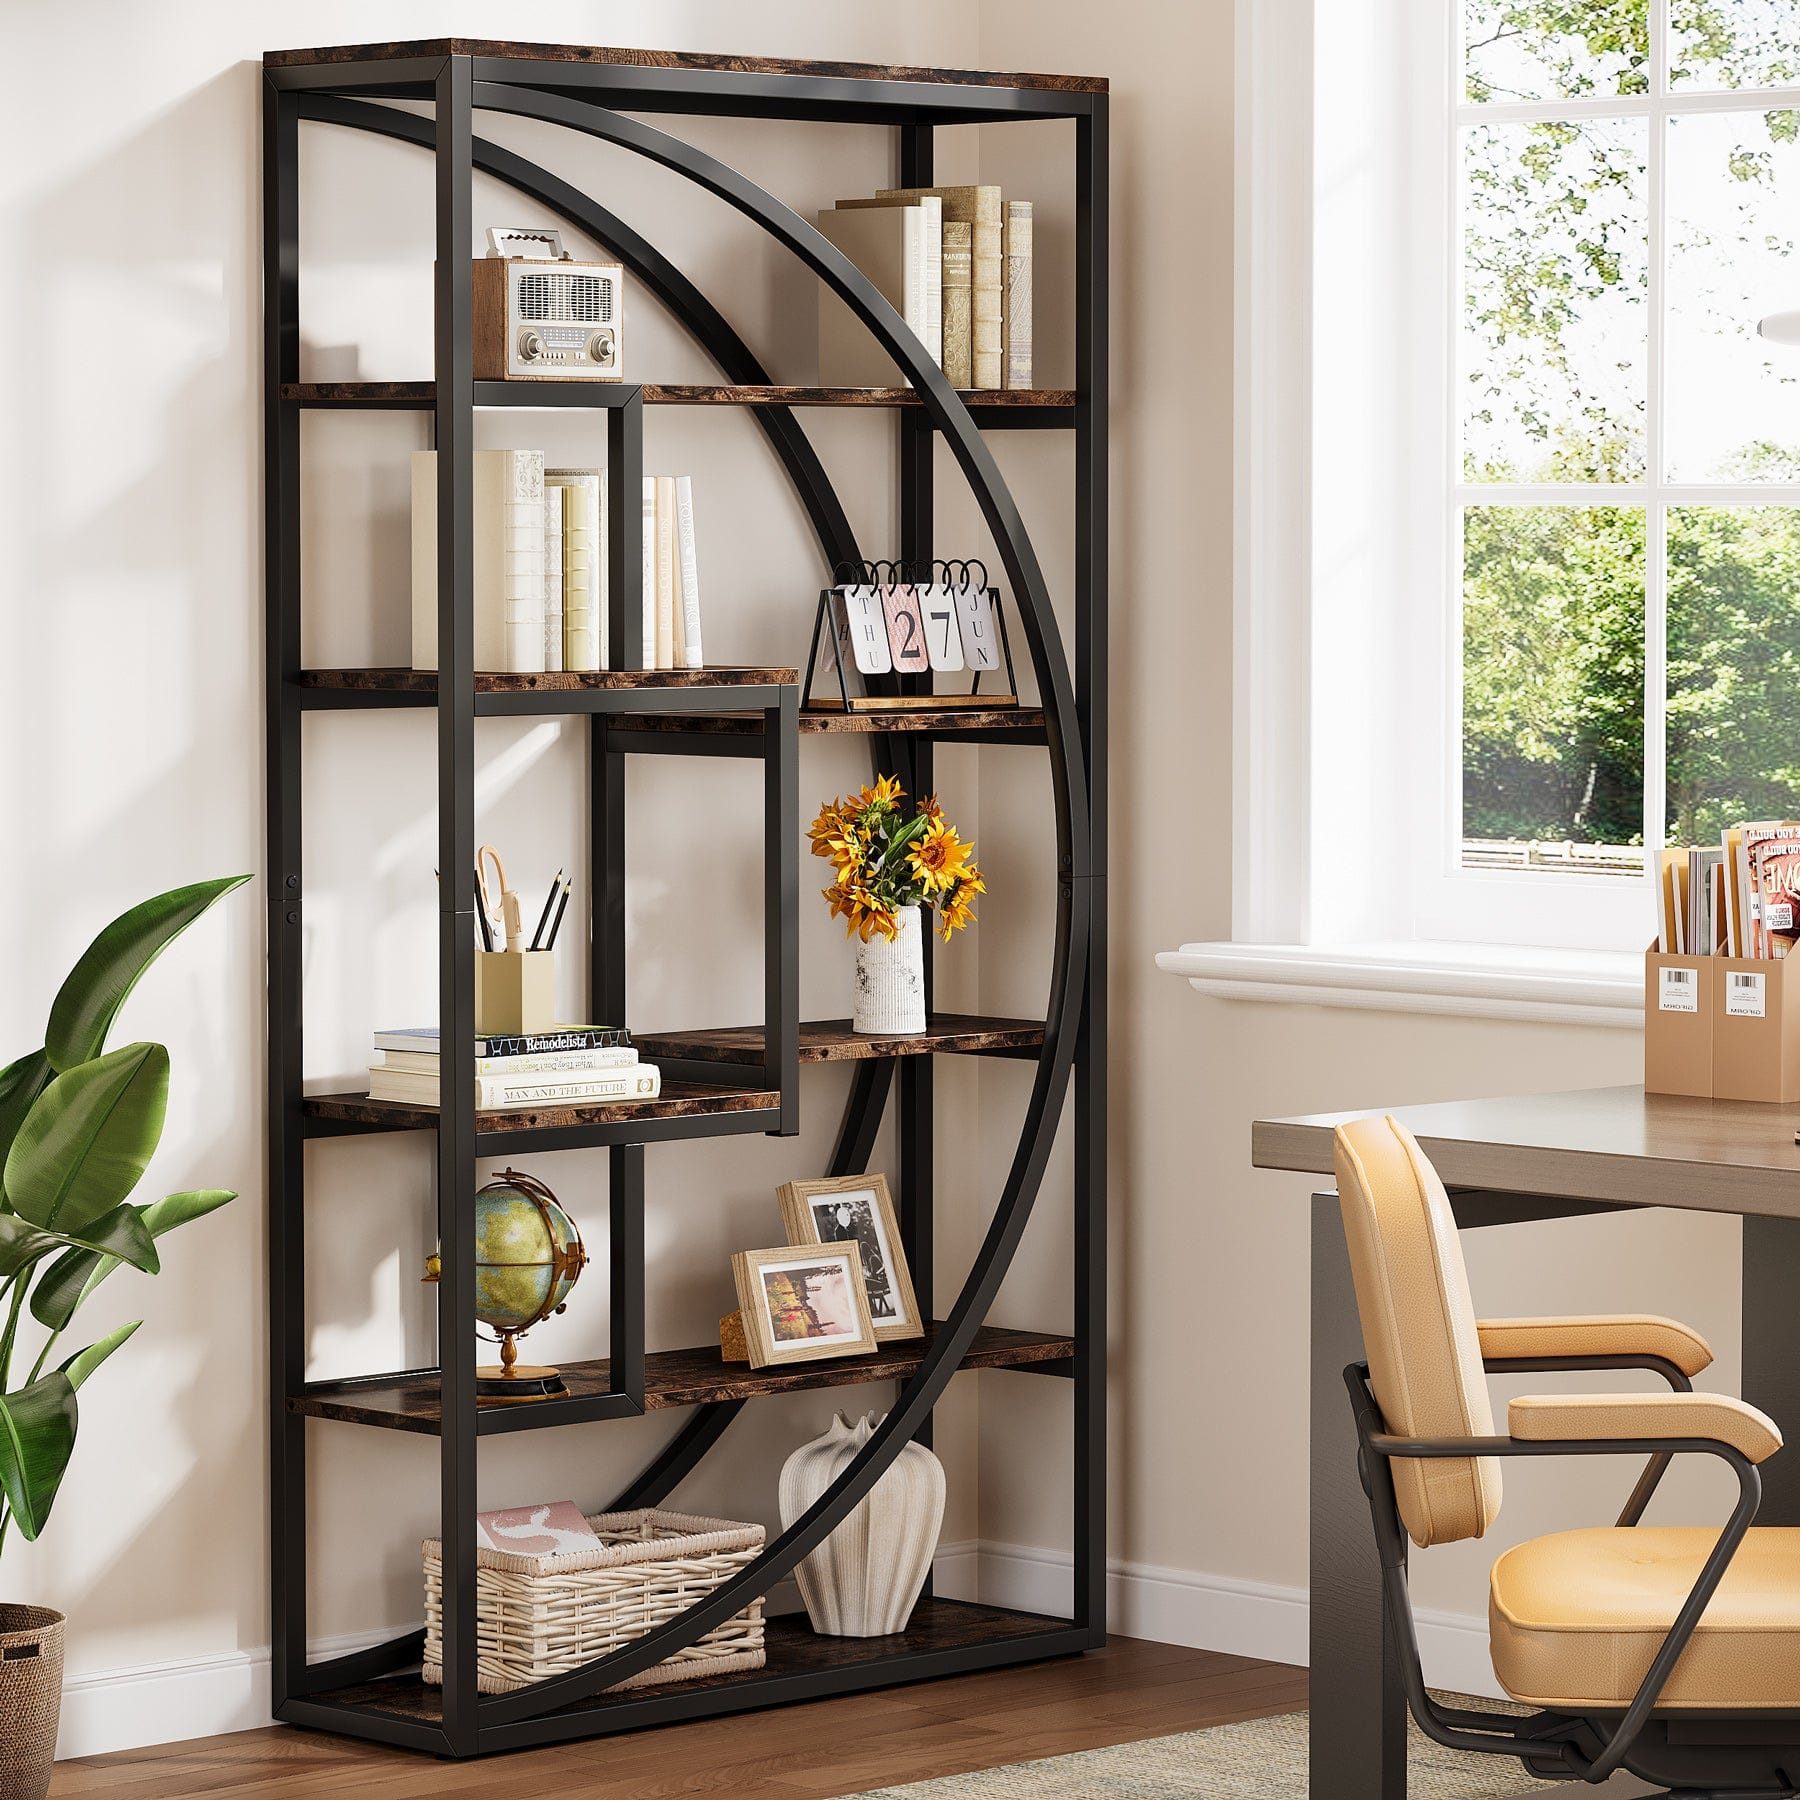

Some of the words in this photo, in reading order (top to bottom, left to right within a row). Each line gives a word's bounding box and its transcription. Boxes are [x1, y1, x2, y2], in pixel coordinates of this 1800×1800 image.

[685, 588, 699, 632] SHACK
[858, 597, 880, 668] THU
[969, 594, 990, 665] JUN
[526, 1034, 587, 1052] Remodelista
[504, 1090, 530, 1101] MAN
[532, 1088, 557, 1099] AND
[559, 1085, 582, 1096] THE
[585, 1082, 627, 1095] FUTURE
